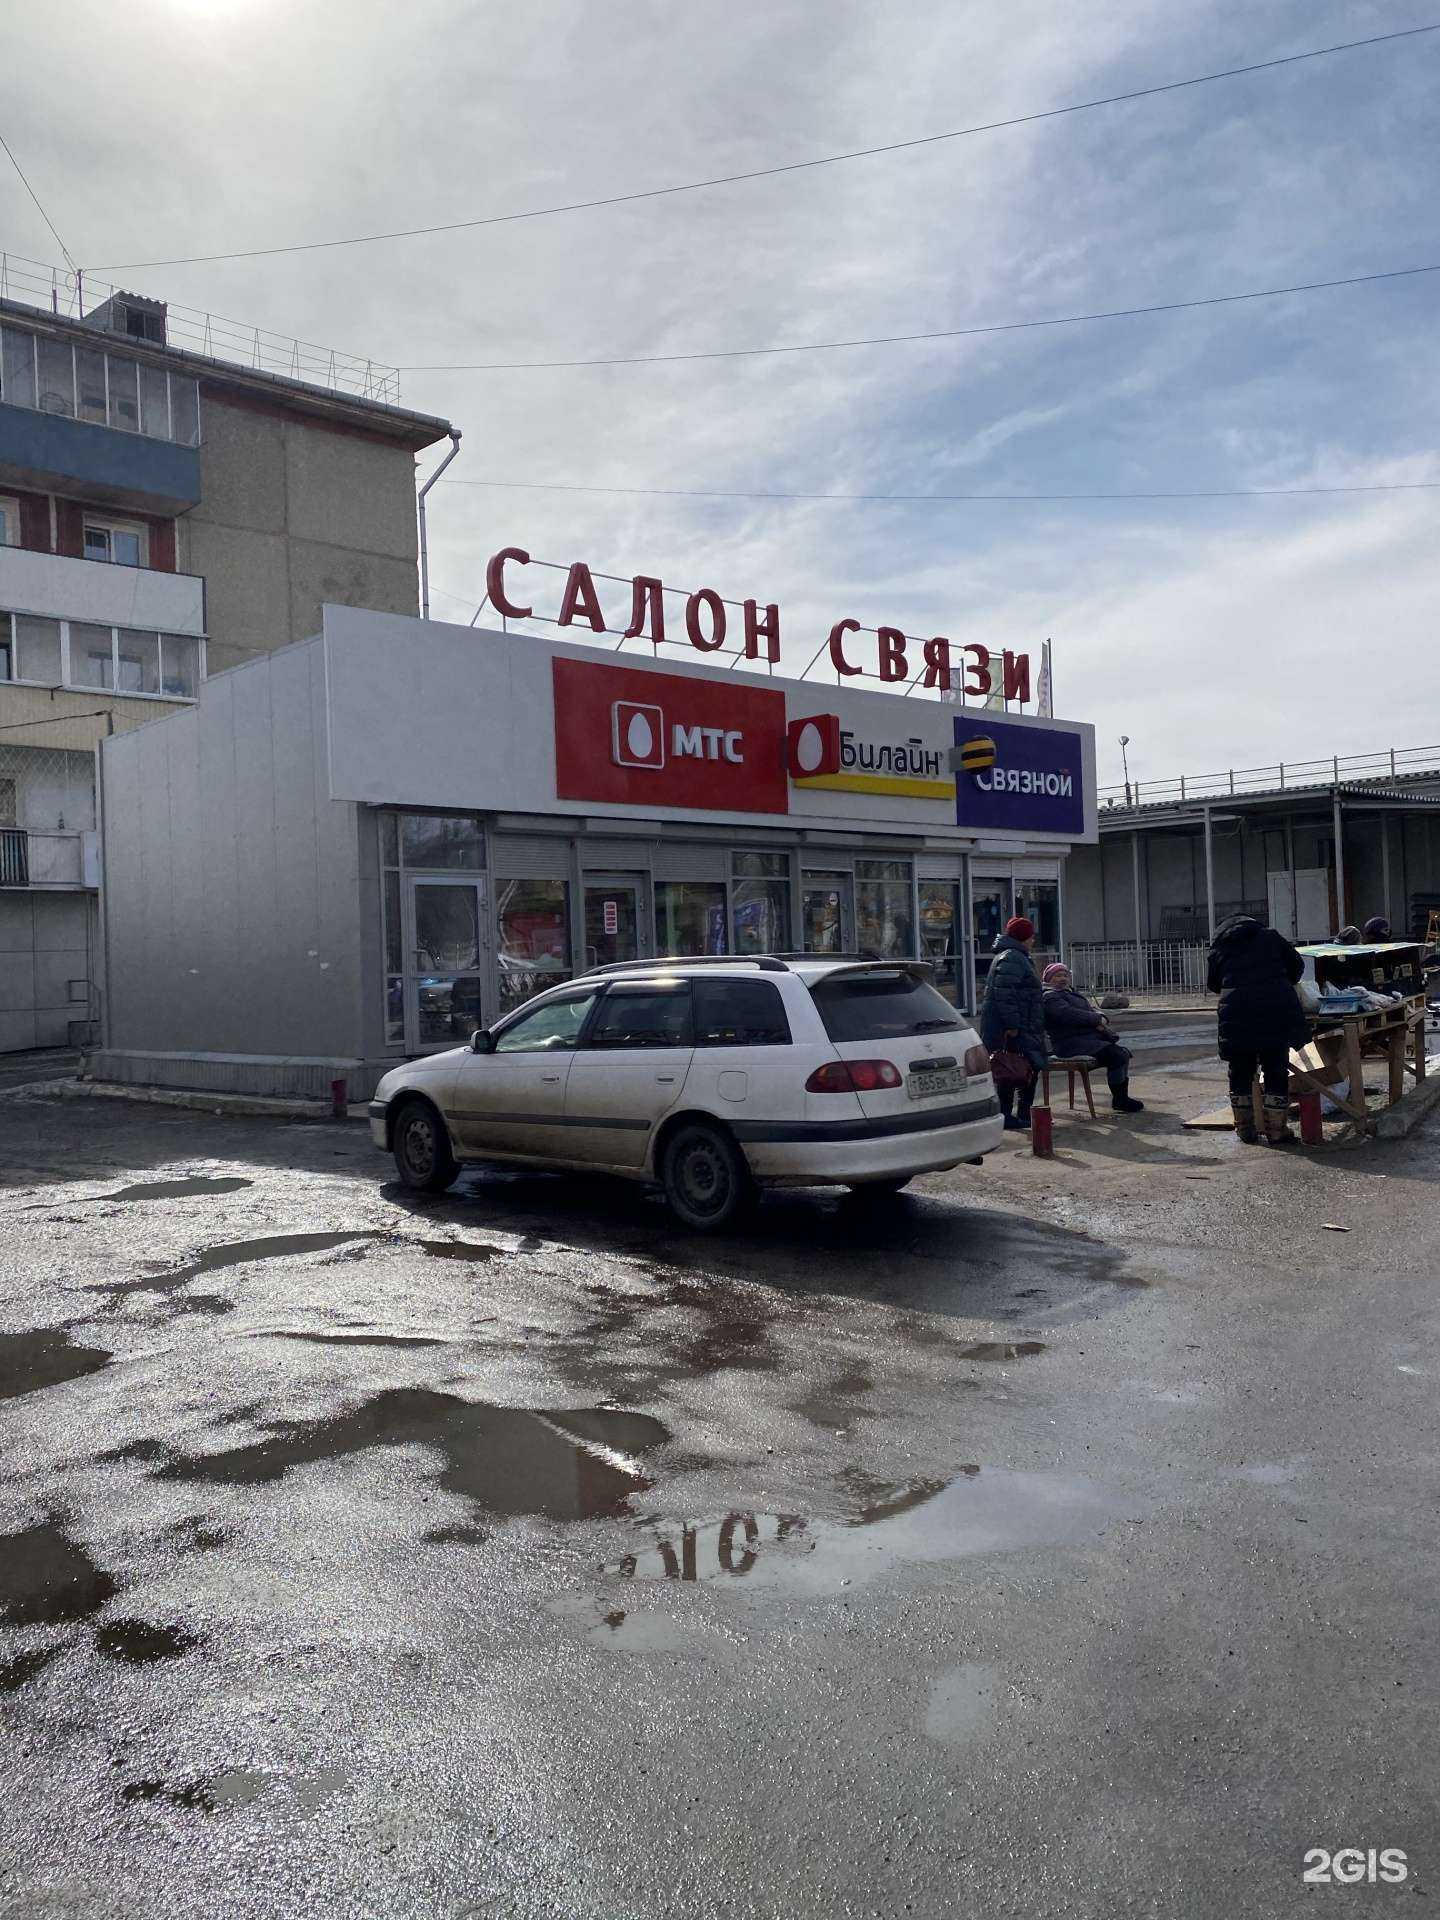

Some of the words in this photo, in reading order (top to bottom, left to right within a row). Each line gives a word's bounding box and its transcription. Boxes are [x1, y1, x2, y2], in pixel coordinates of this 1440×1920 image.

[487, 547, 780, 662] САЛОН
[830, 619, 1029, 702] СВЯЗИ
[672, 725, 743, 763] МТС
